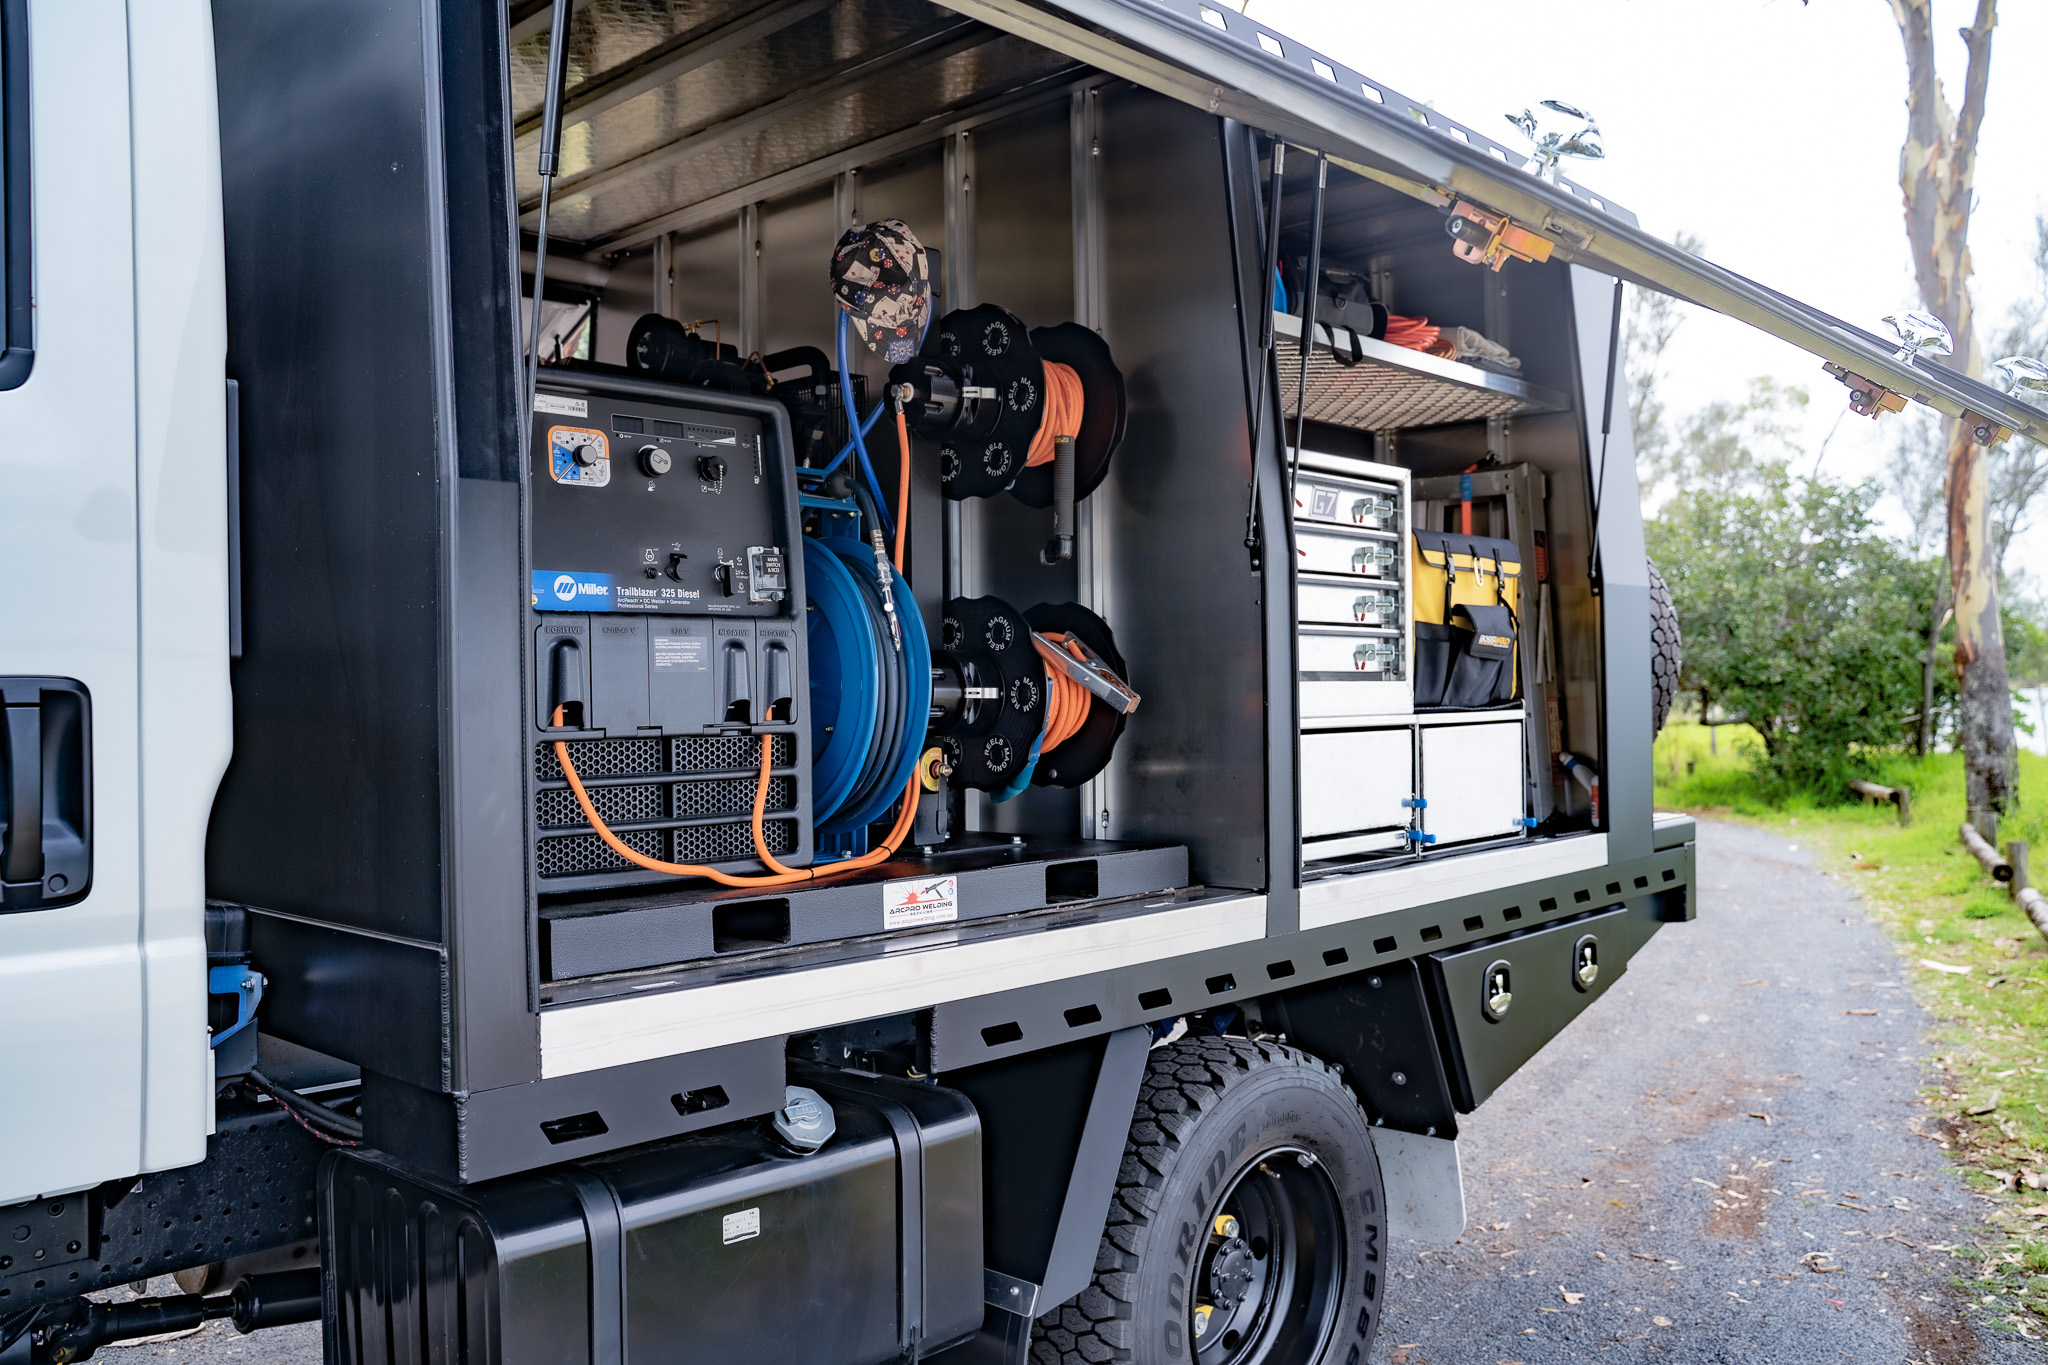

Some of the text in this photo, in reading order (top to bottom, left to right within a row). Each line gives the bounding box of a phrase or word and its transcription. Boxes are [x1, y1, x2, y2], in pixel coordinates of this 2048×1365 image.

[983, 321, 1008, 356] MAGNUM REELS
[1008, 381, 1018, 412] REELS
[1020, 377, 1034, 412] MAGNUM
[983, 442, 1009, 477] REELS MAGNUM
[1313, 490, 1338, 515] G7
[578, 582, 607, 595] Miller
[616, 586, 700, 599] Trailblazer 325 Diesel
[545, 626, 583, 634] POSITIVE
[719, 628, 749, 636] NEGATIVE
[760, 629, 790, 637] NEGATIVE
[985, 616, 1012, 651] MAGNUM REELS
[1010, 677, 1037, 713] MAGNUM REELS
[985, 737, 1010, 773] REELS MAGNUM
[889, 901, 953, 915] ARCPRO WELDING
[1164, 1120, 1247, 1360] ODRIDE
